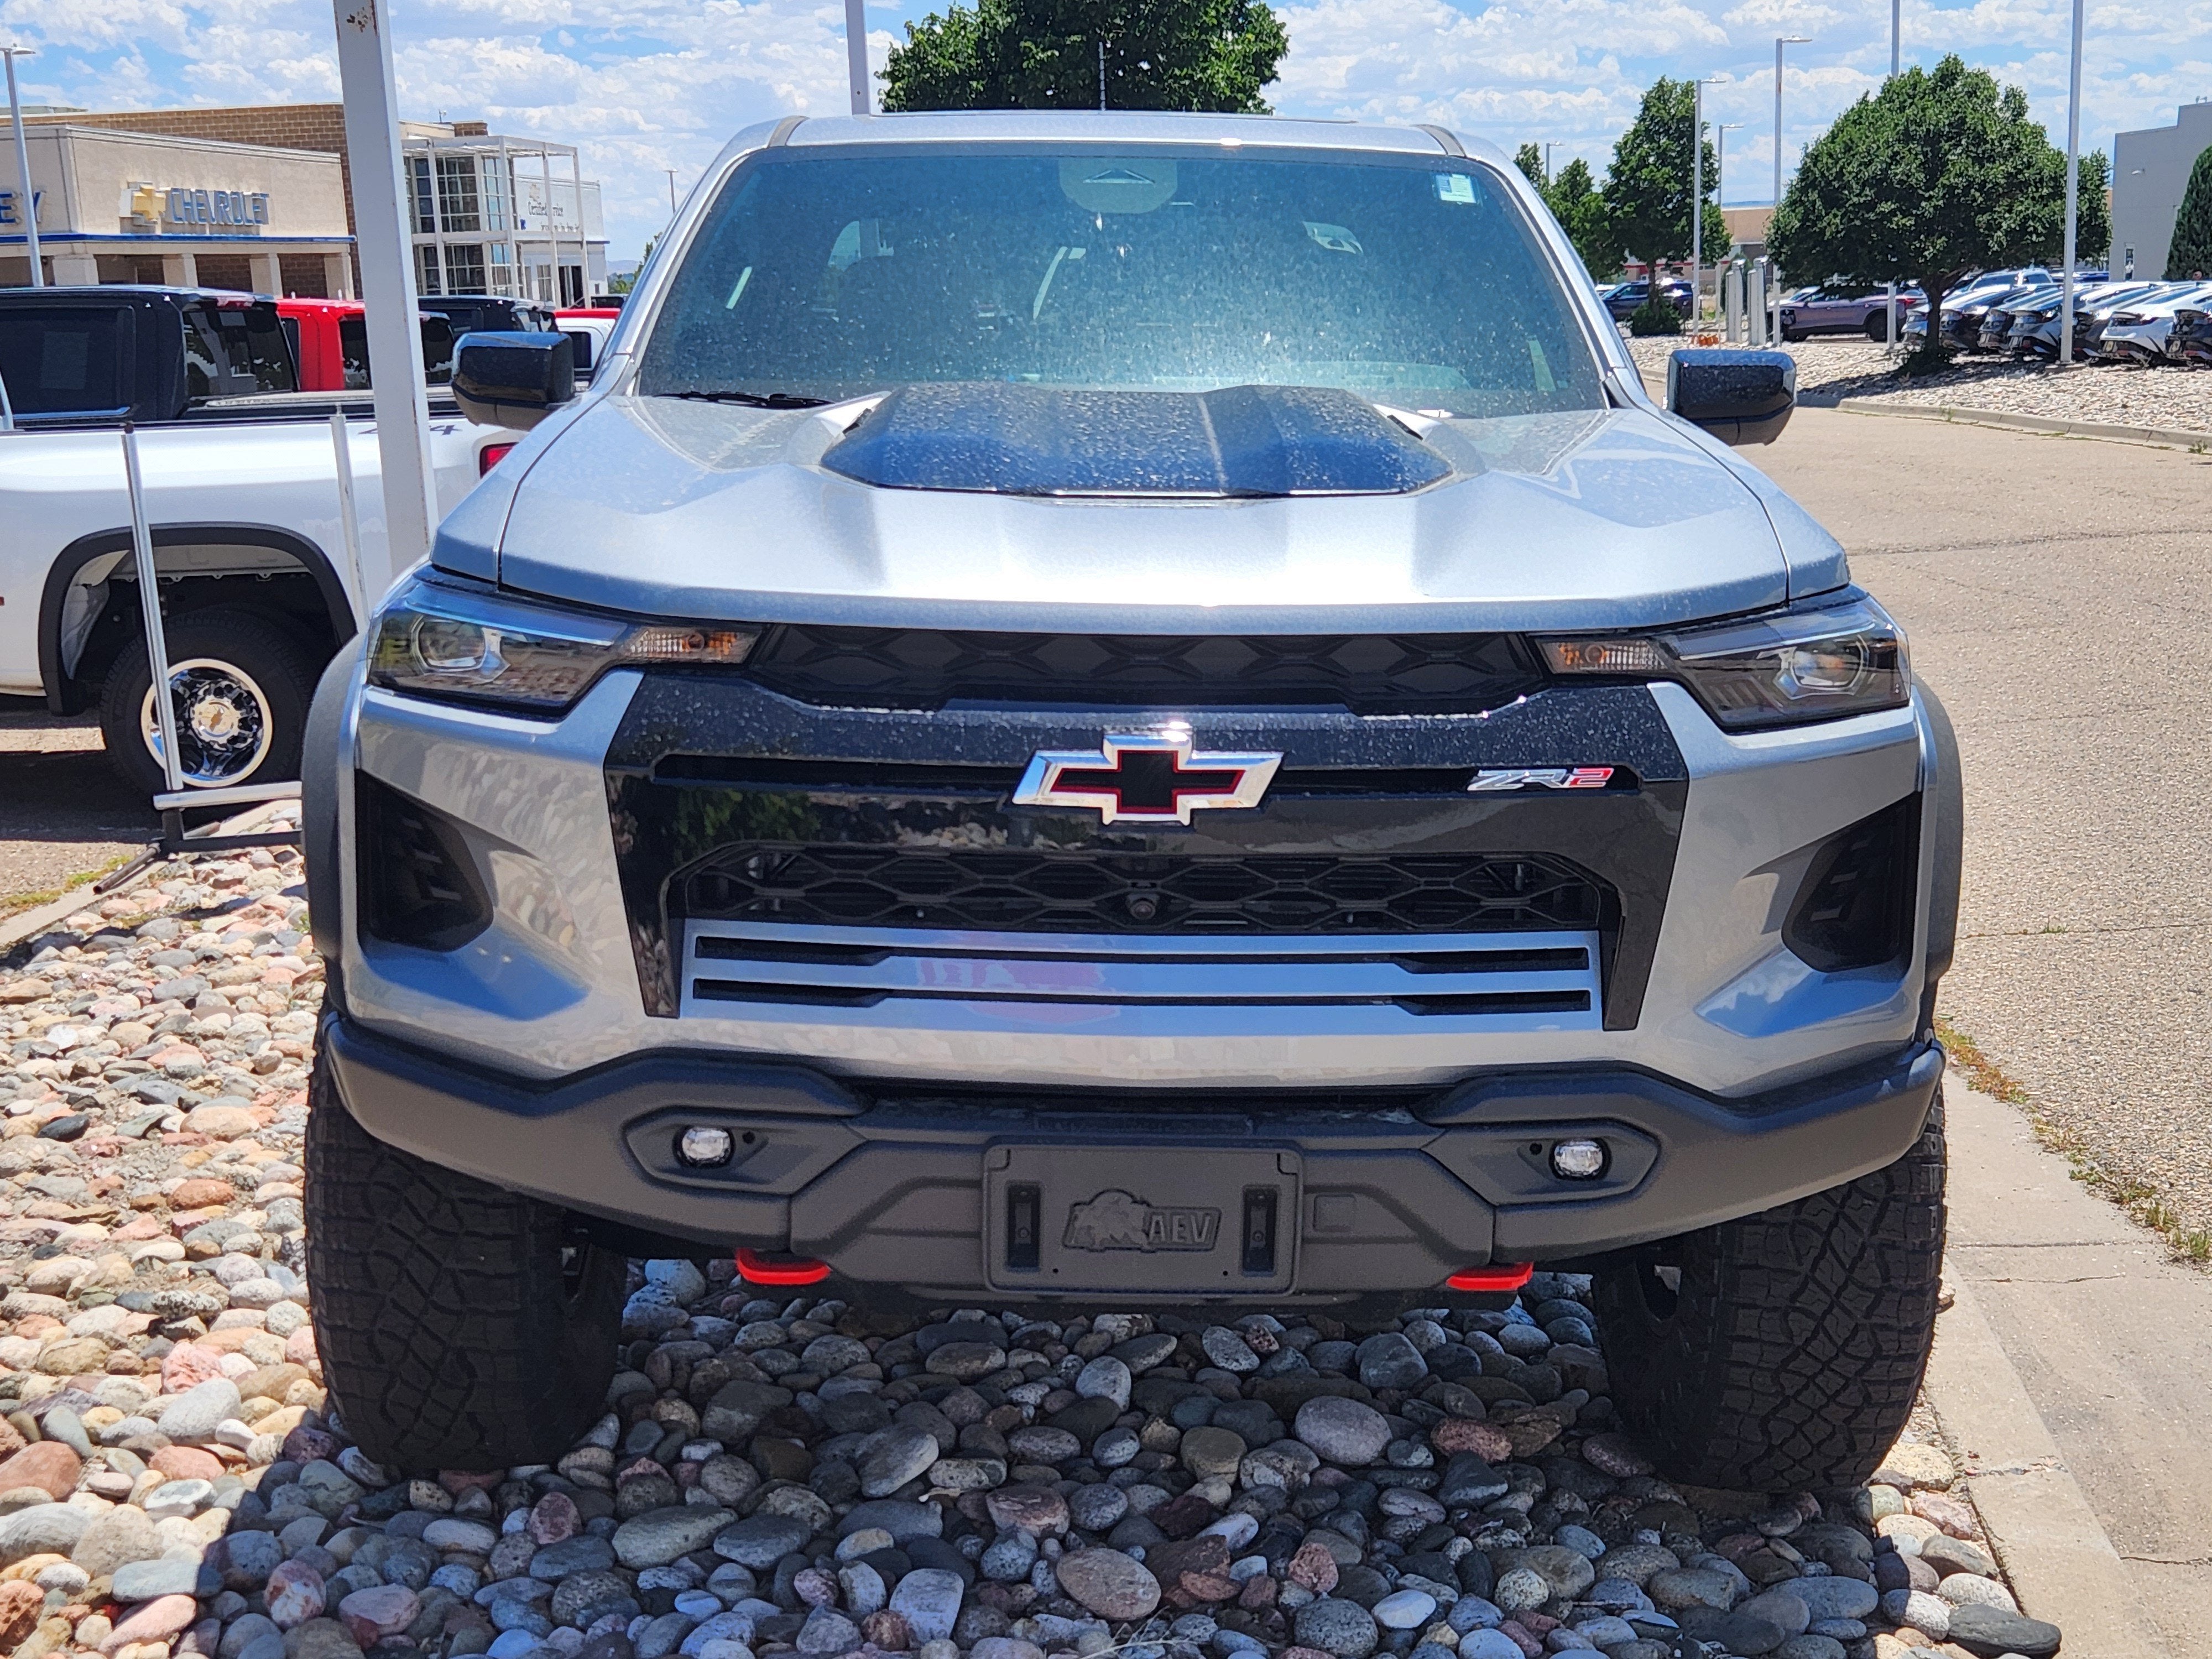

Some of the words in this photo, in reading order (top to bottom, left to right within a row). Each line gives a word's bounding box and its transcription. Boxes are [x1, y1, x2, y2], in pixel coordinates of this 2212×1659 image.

[170, 187, 269, 226] CHEVROLET
[1467, 767, 1615, 791] ZR2
[1149, 1214, 1211, 1243] AEV
